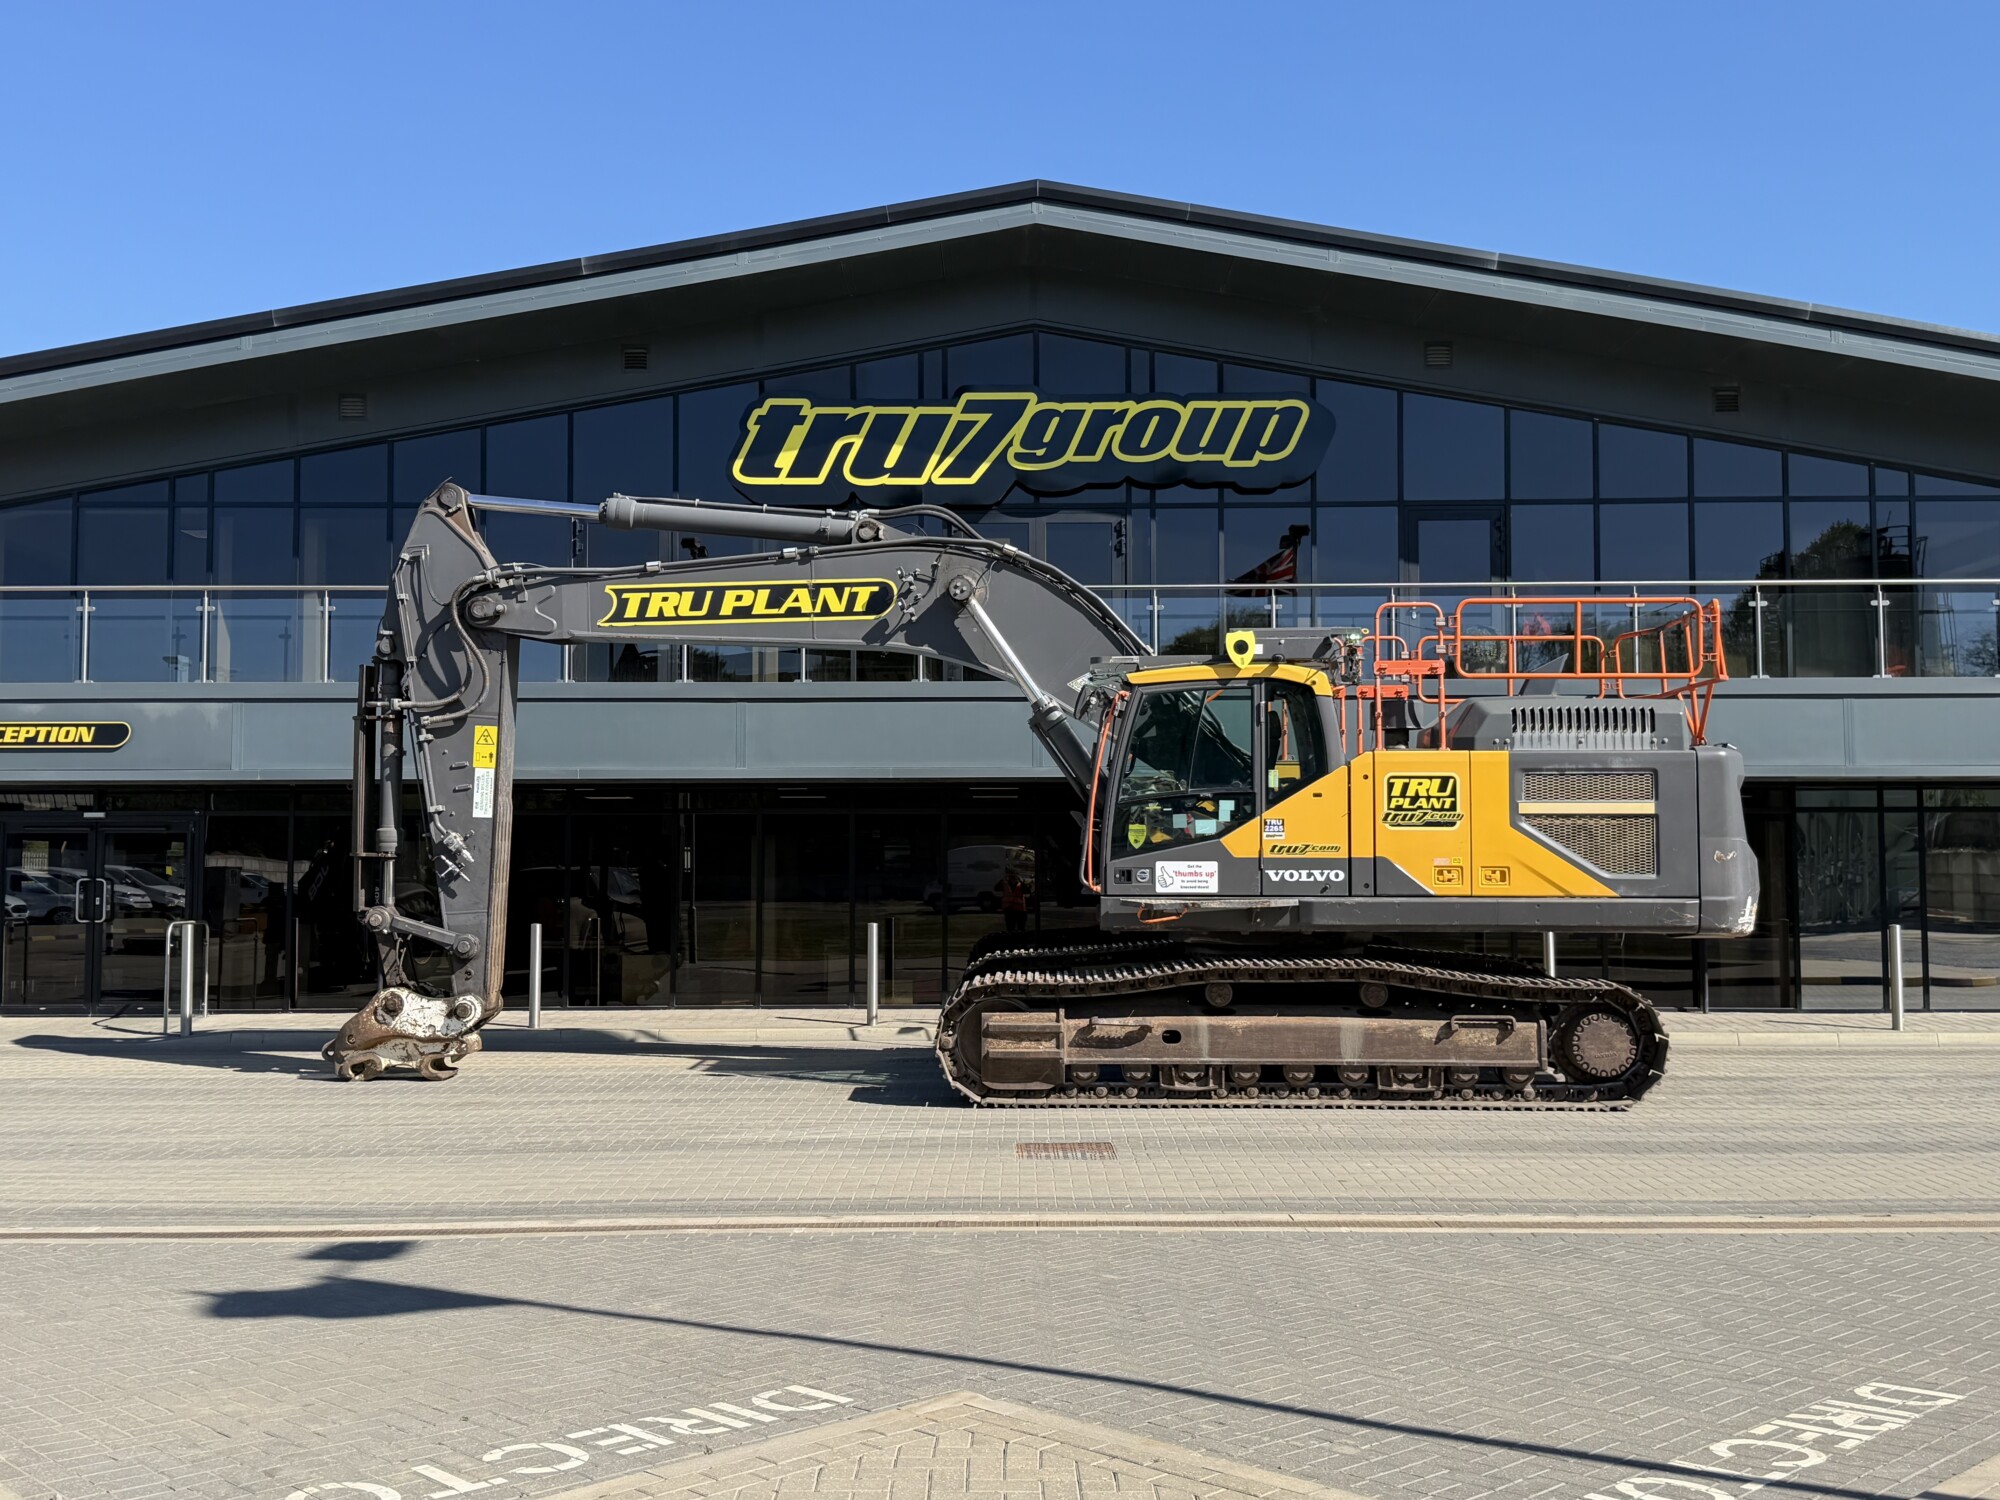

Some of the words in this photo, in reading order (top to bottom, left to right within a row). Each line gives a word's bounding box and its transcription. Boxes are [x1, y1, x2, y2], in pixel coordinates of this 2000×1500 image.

[731, 391, 1310, 485] tru7group
[621, 590, 713, 618] TRU
[719, 585, 879, 616] PLANT
[1389, 778, 1454, 797] TRU
[1389, 797, 1455, 809] PLANT
[1265, 869, 1345, 882] VOLVO
